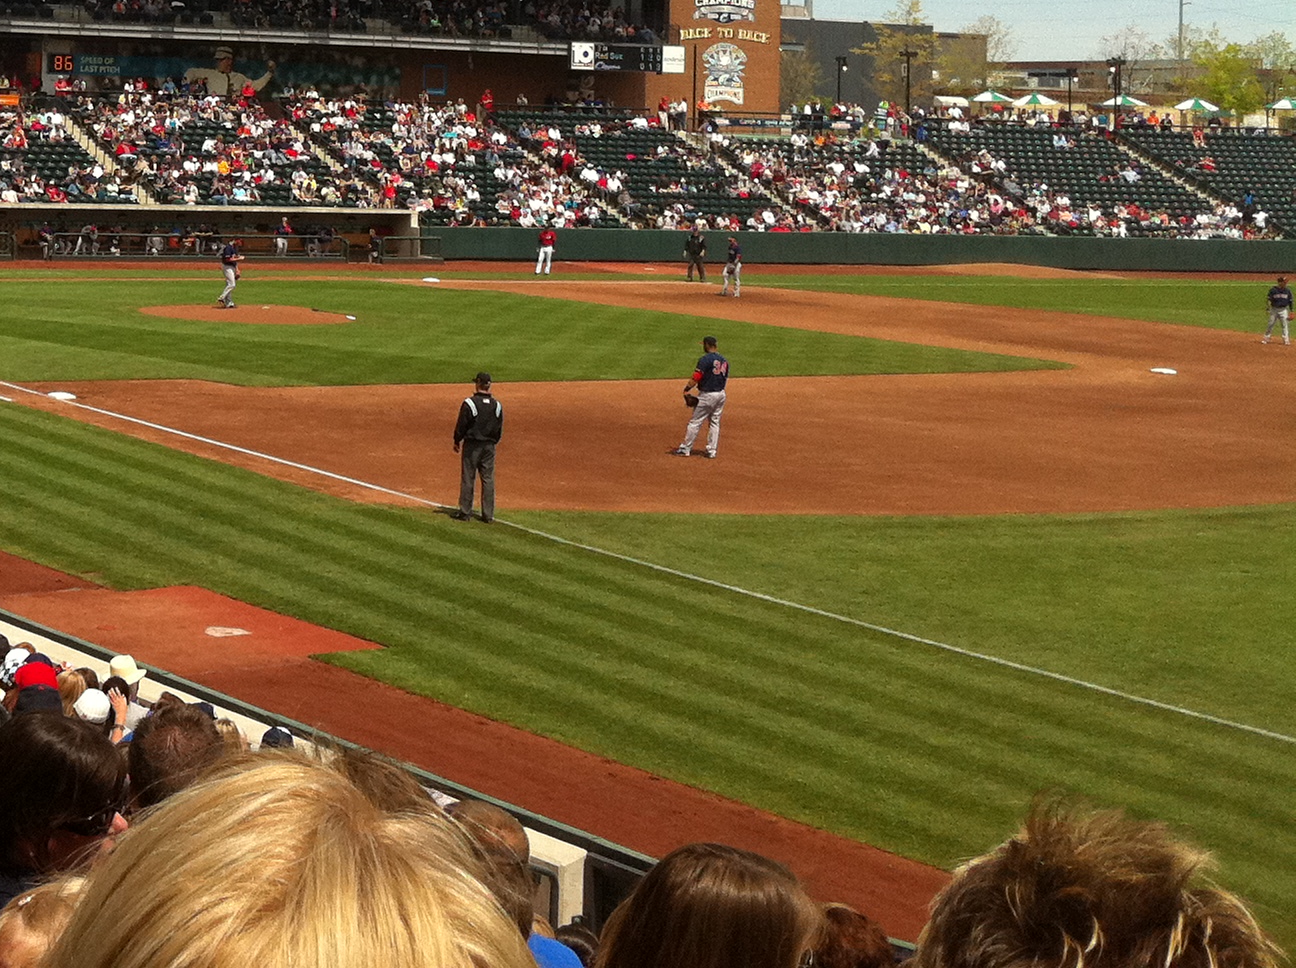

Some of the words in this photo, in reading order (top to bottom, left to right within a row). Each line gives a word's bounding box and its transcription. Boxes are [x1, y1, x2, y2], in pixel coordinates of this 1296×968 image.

[680, 28, 712, 40] BACK
[717, 27, 734, 38] TO
[738, 29, 770, 43] BACK
[54, 56, 73, 70] 86
[104, 57, 114, 65] OF
[712, 360, 728, 376] 34
